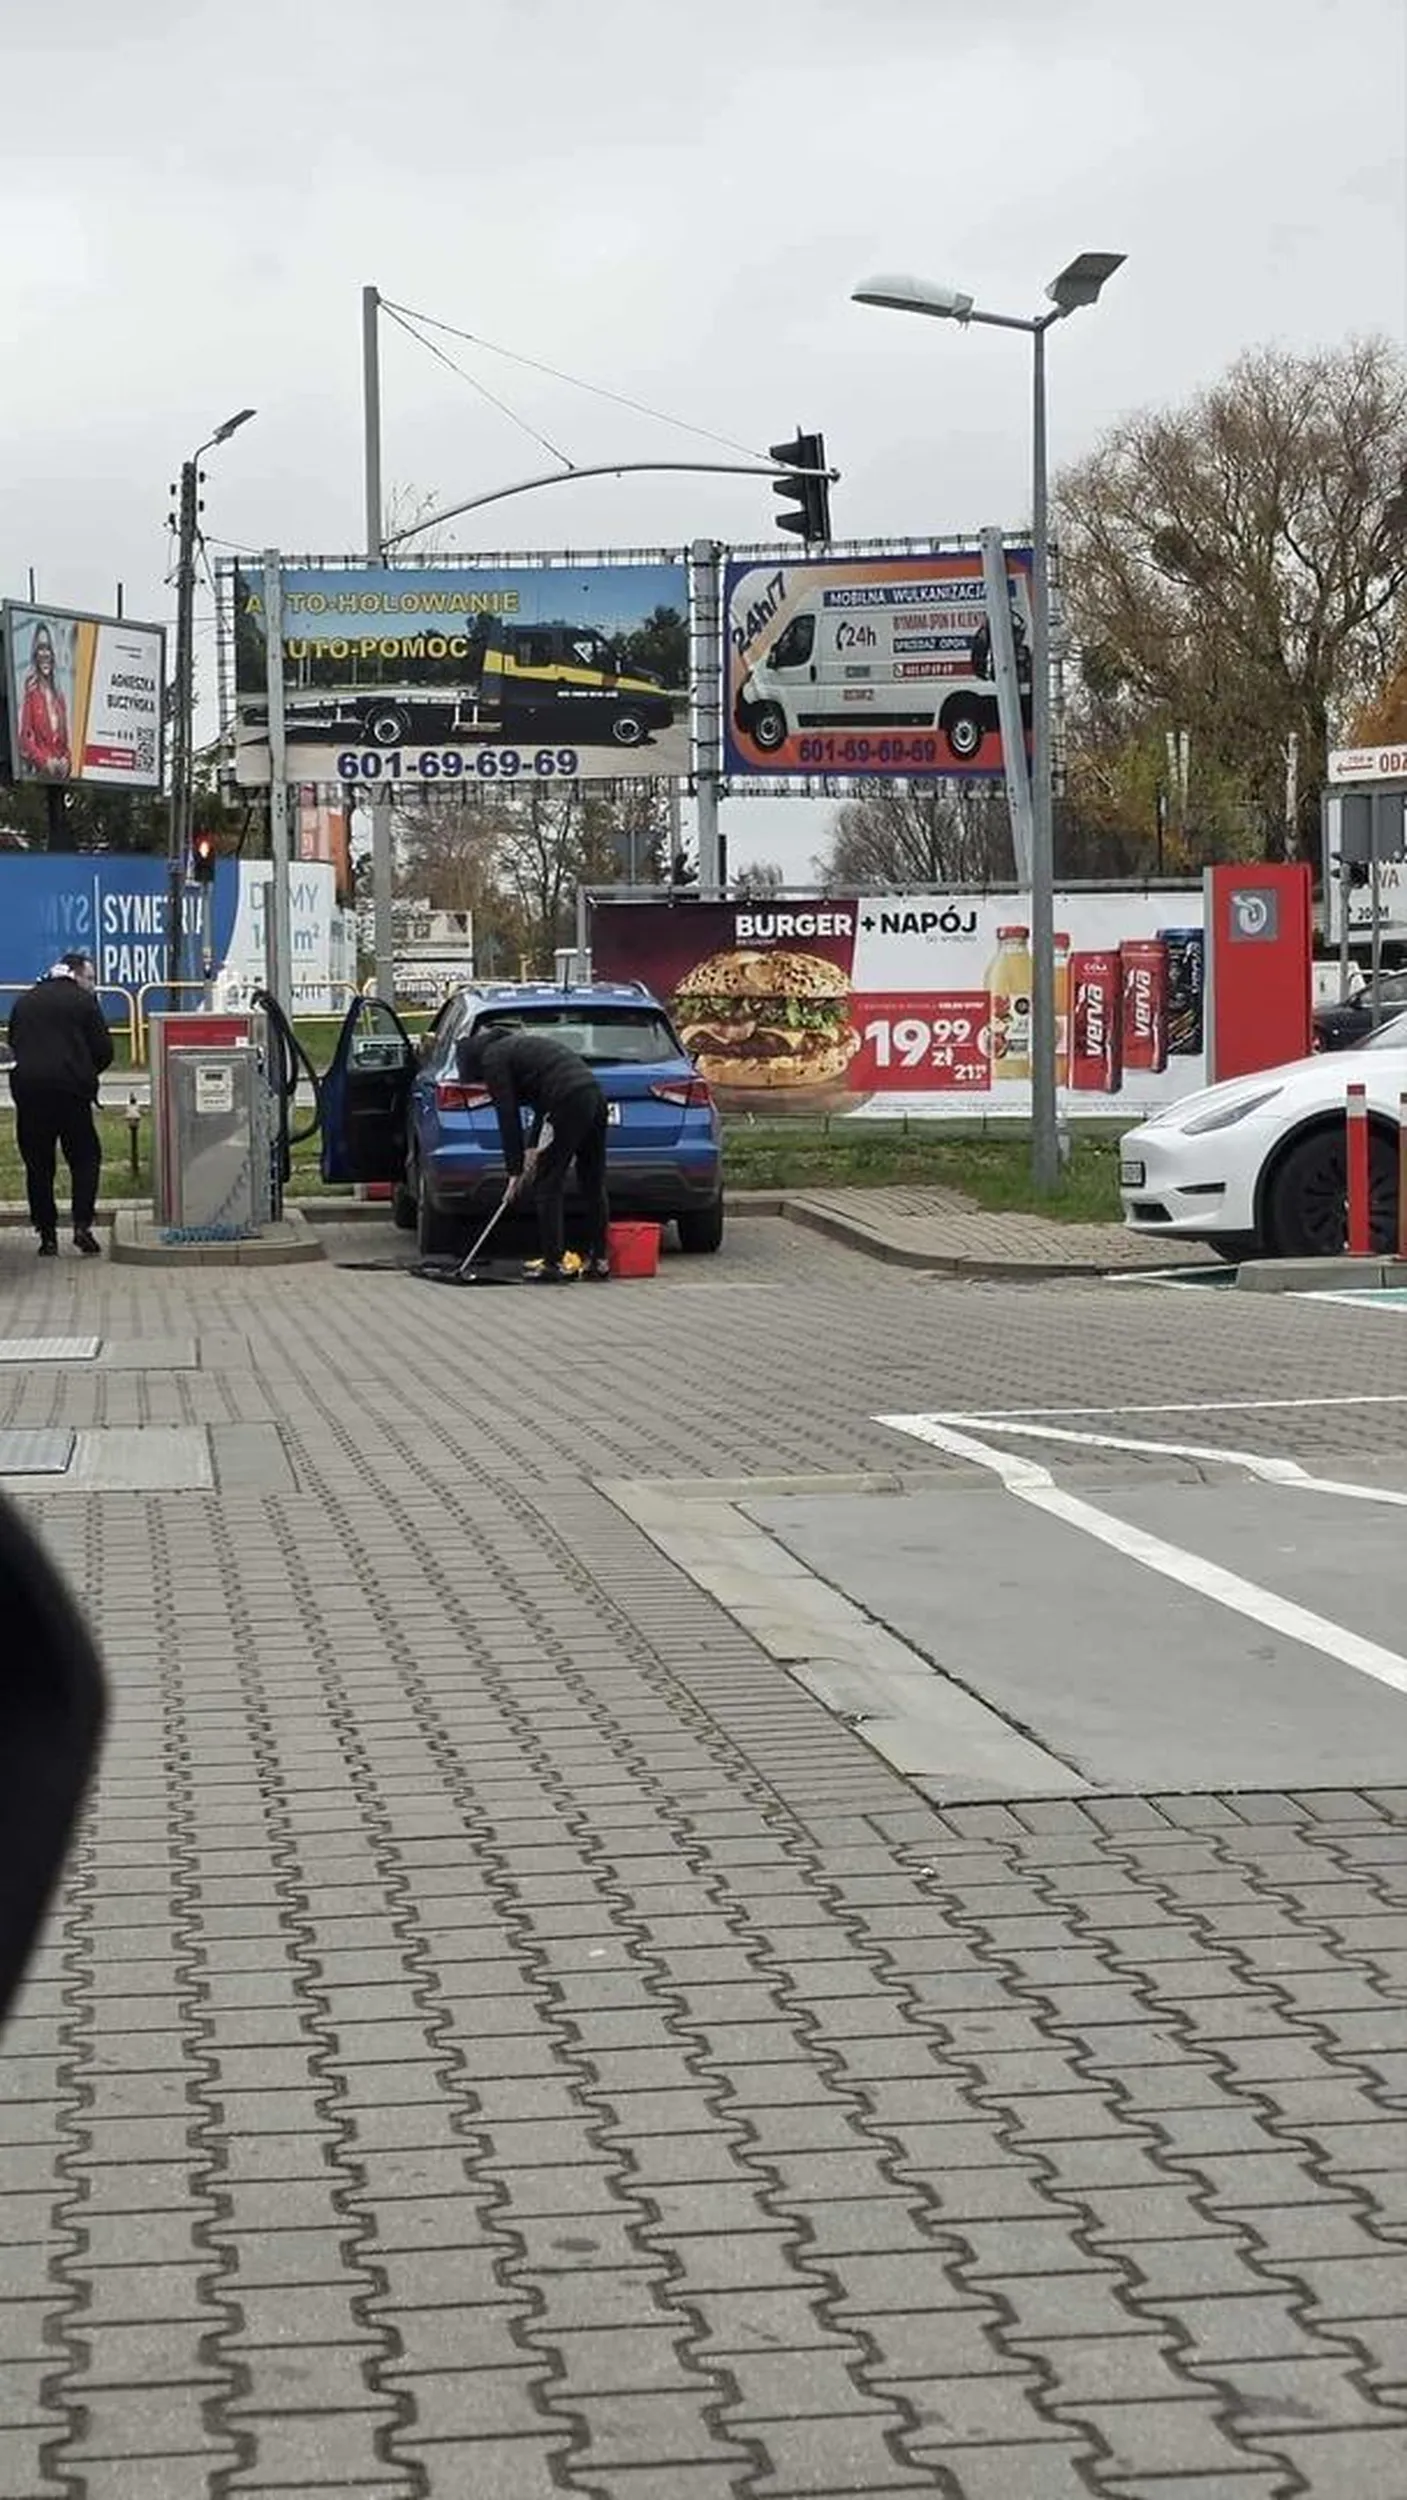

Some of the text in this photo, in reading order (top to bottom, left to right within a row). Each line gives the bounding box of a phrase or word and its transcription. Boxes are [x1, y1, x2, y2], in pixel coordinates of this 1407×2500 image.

[244, 590, 520, 614] ATO-HOLOWANIE
[829, 588, 886, 606] MOBILNA
[283, 635, 470, 660] UTO-POMOC
[846, 625, 877, 648] 24h
[337, 749, 579, 779] 601-69-69-69
[800, 738, 937, 763] 601-69-69-69
[735, 912, 853, 938] BURGER
[880, 905, 978, 934] NAPÓJ
[1134, 969, 1152, 1038] verva
[1086, 983, 1104, 1056] verva
[865, 1019, 932, 1067] 19
[932, 1019, 972, 1043] 99
